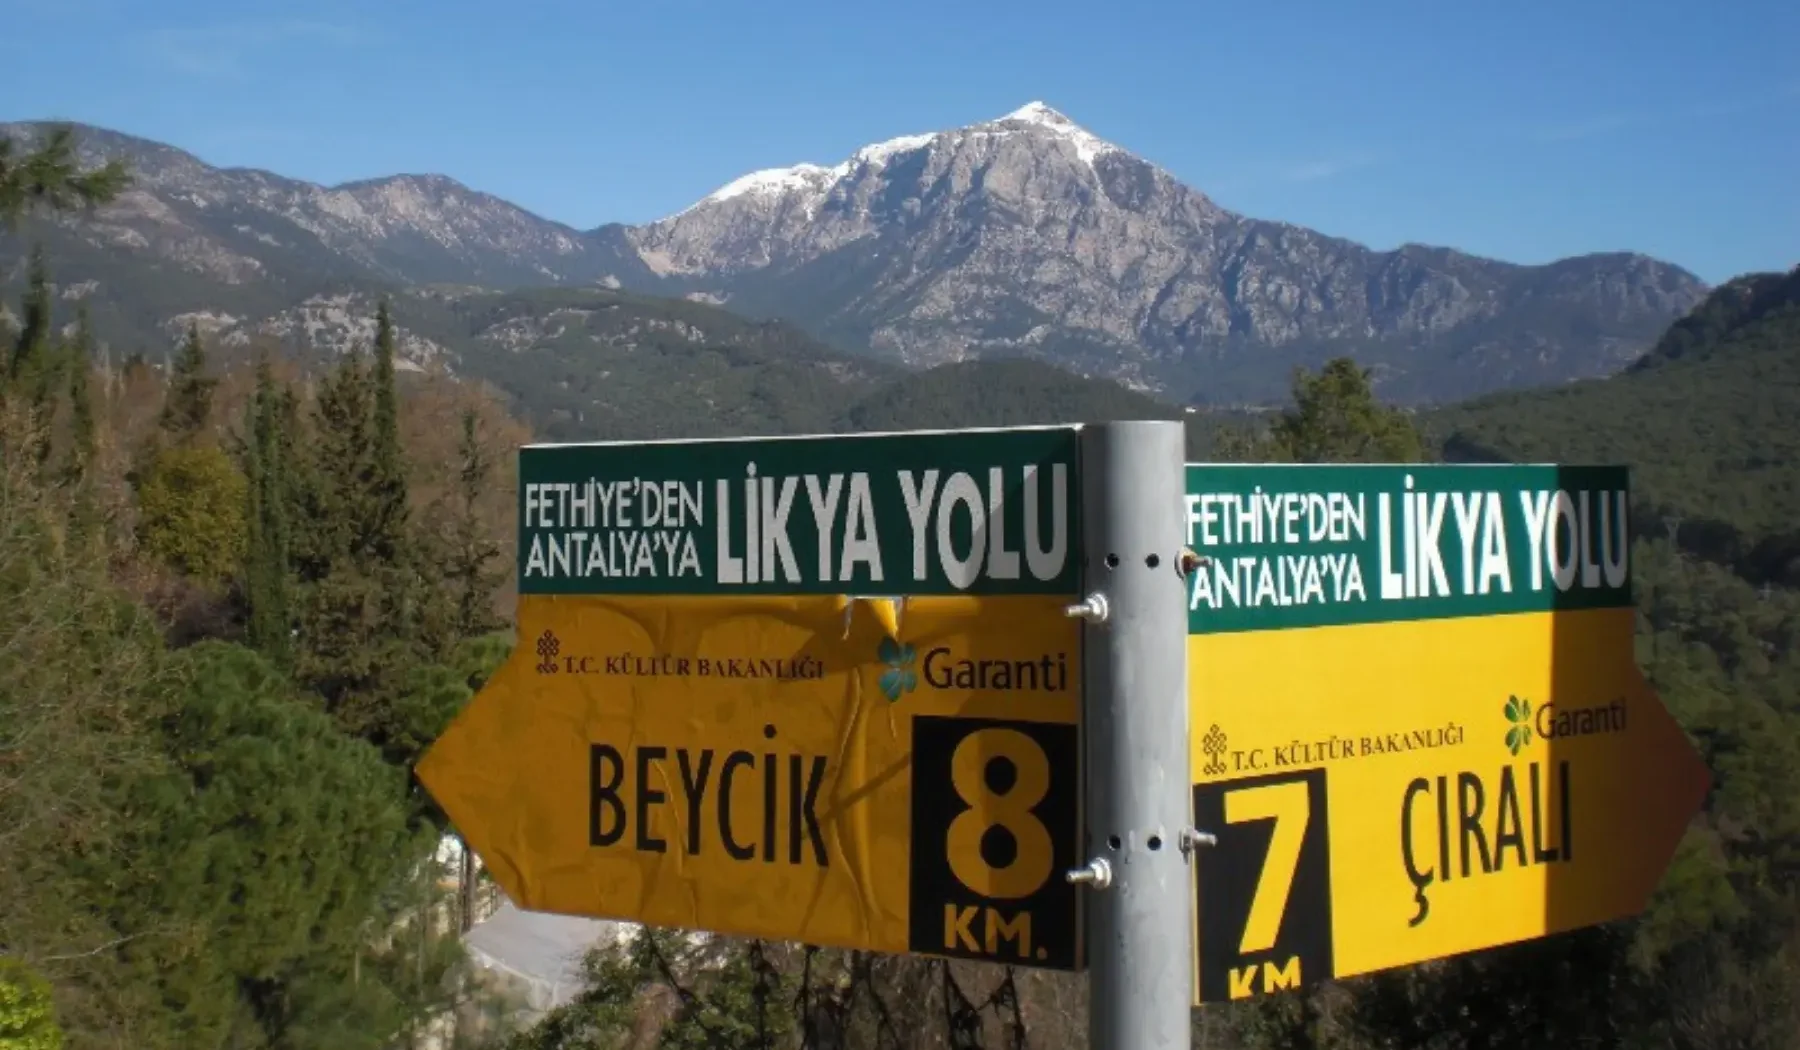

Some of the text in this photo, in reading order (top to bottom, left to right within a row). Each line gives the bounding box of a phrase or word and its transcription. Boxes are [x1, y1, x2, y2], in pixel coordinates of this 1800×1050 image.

[525, 476, 703, 527] FETHİYE'DEN
[716, 461, 1067, 590] LİKYA YOLU
[1184, 485, 1366, 545] FETHİYE'DEN
[524, 530, 703, 577] ANTALYA'YA
[1379, 474, 1628, 599] LİKYA YOLU
[1190, 552, 1367, 610] ANTALYA'YA
[563, 652, 825, 680] T.C. KÜLTÜR BAKANLIĞI
[923, 647, 1067, 692] Garanti
[1231, 721, 1464, 771] T.C. KÜLTÜR BAKANLIĞI
[1535, 696, 1628, 742] Garanti
[589, 723, 830, 868] BEYCİK
[946, 727, 1054, 899] 8
[1223, 779, 1311, 954] 7
[1401, 759, 1573, 928] ÇIRALI
[944, 903, 1049, 960] KM.
